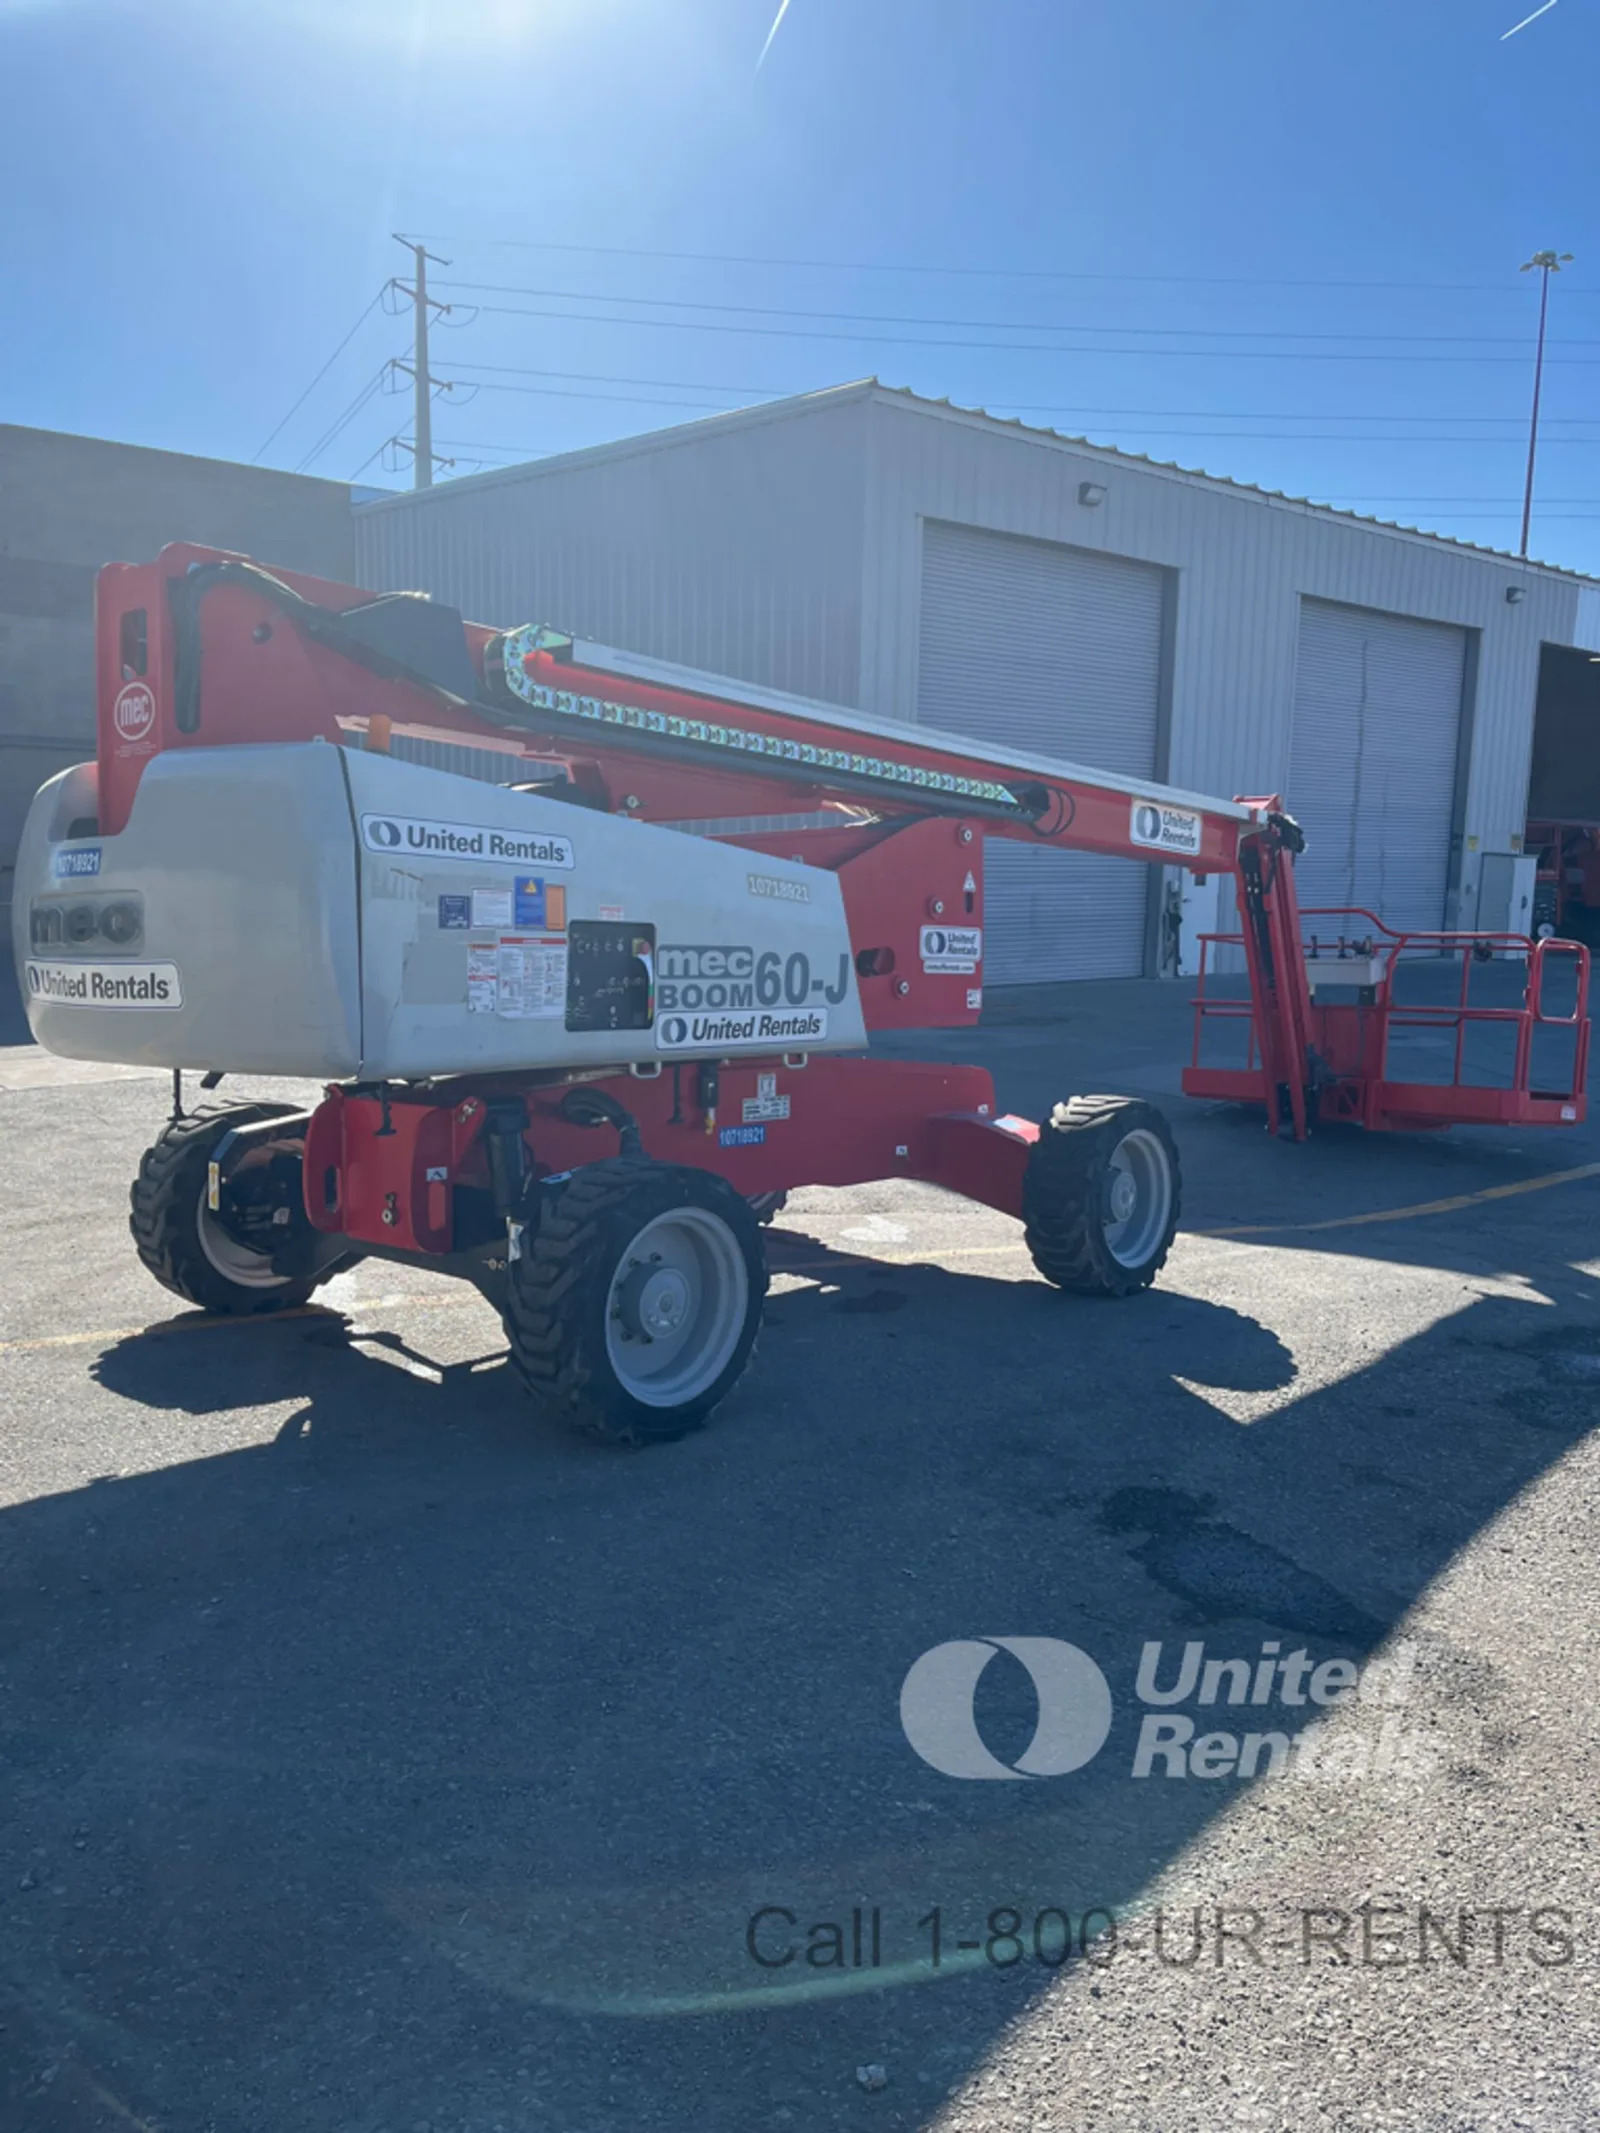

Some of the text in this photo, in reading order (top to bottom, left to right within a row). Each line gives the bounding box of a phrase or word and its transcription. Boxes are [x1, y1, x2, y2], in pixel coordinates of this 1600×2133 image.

[120, 694, 149, 727] mec
[1162, 810, 1196, 831] United
[407, 825, 566, 862] United Rentals
[1161, 827, 1196, 848] Rentals
[749, 875, 810, 902] 10718921
[947, 932, 976, 945] United
[658, 949, 753, 977] mec
[40, 968, 169, 1000] United Rentals
[657, 951, 849, 1010] BOOM 60-J
[691, 1013, 821, 1041] United Rentals
